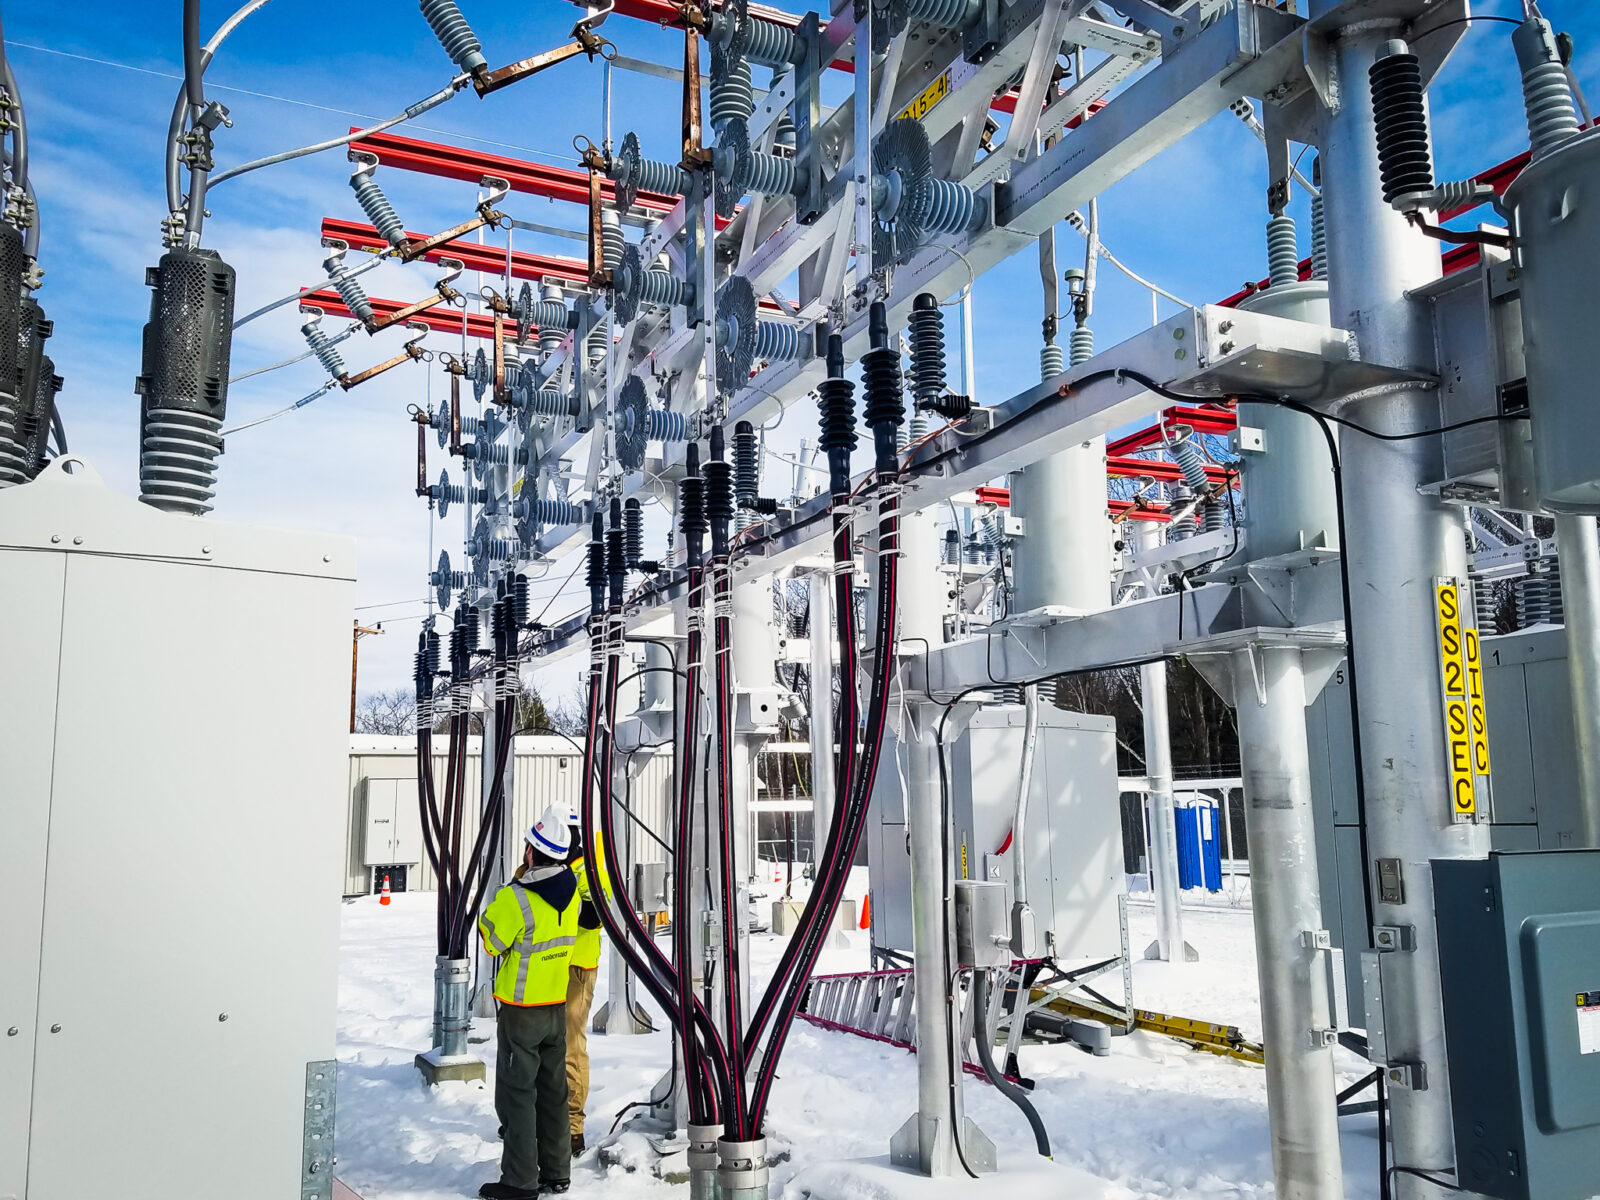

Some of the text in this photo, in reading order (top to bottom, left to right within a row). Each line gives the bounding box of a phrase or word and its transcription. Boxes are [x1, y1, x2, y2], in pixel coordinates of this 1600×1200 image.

[1336, 669, 1345, 685] 5
[1493, 650, 1501, 666] 1
[1439, 588, 1472, 810] SS2 SEC
[1465, 632, 1487, 771] DISC
